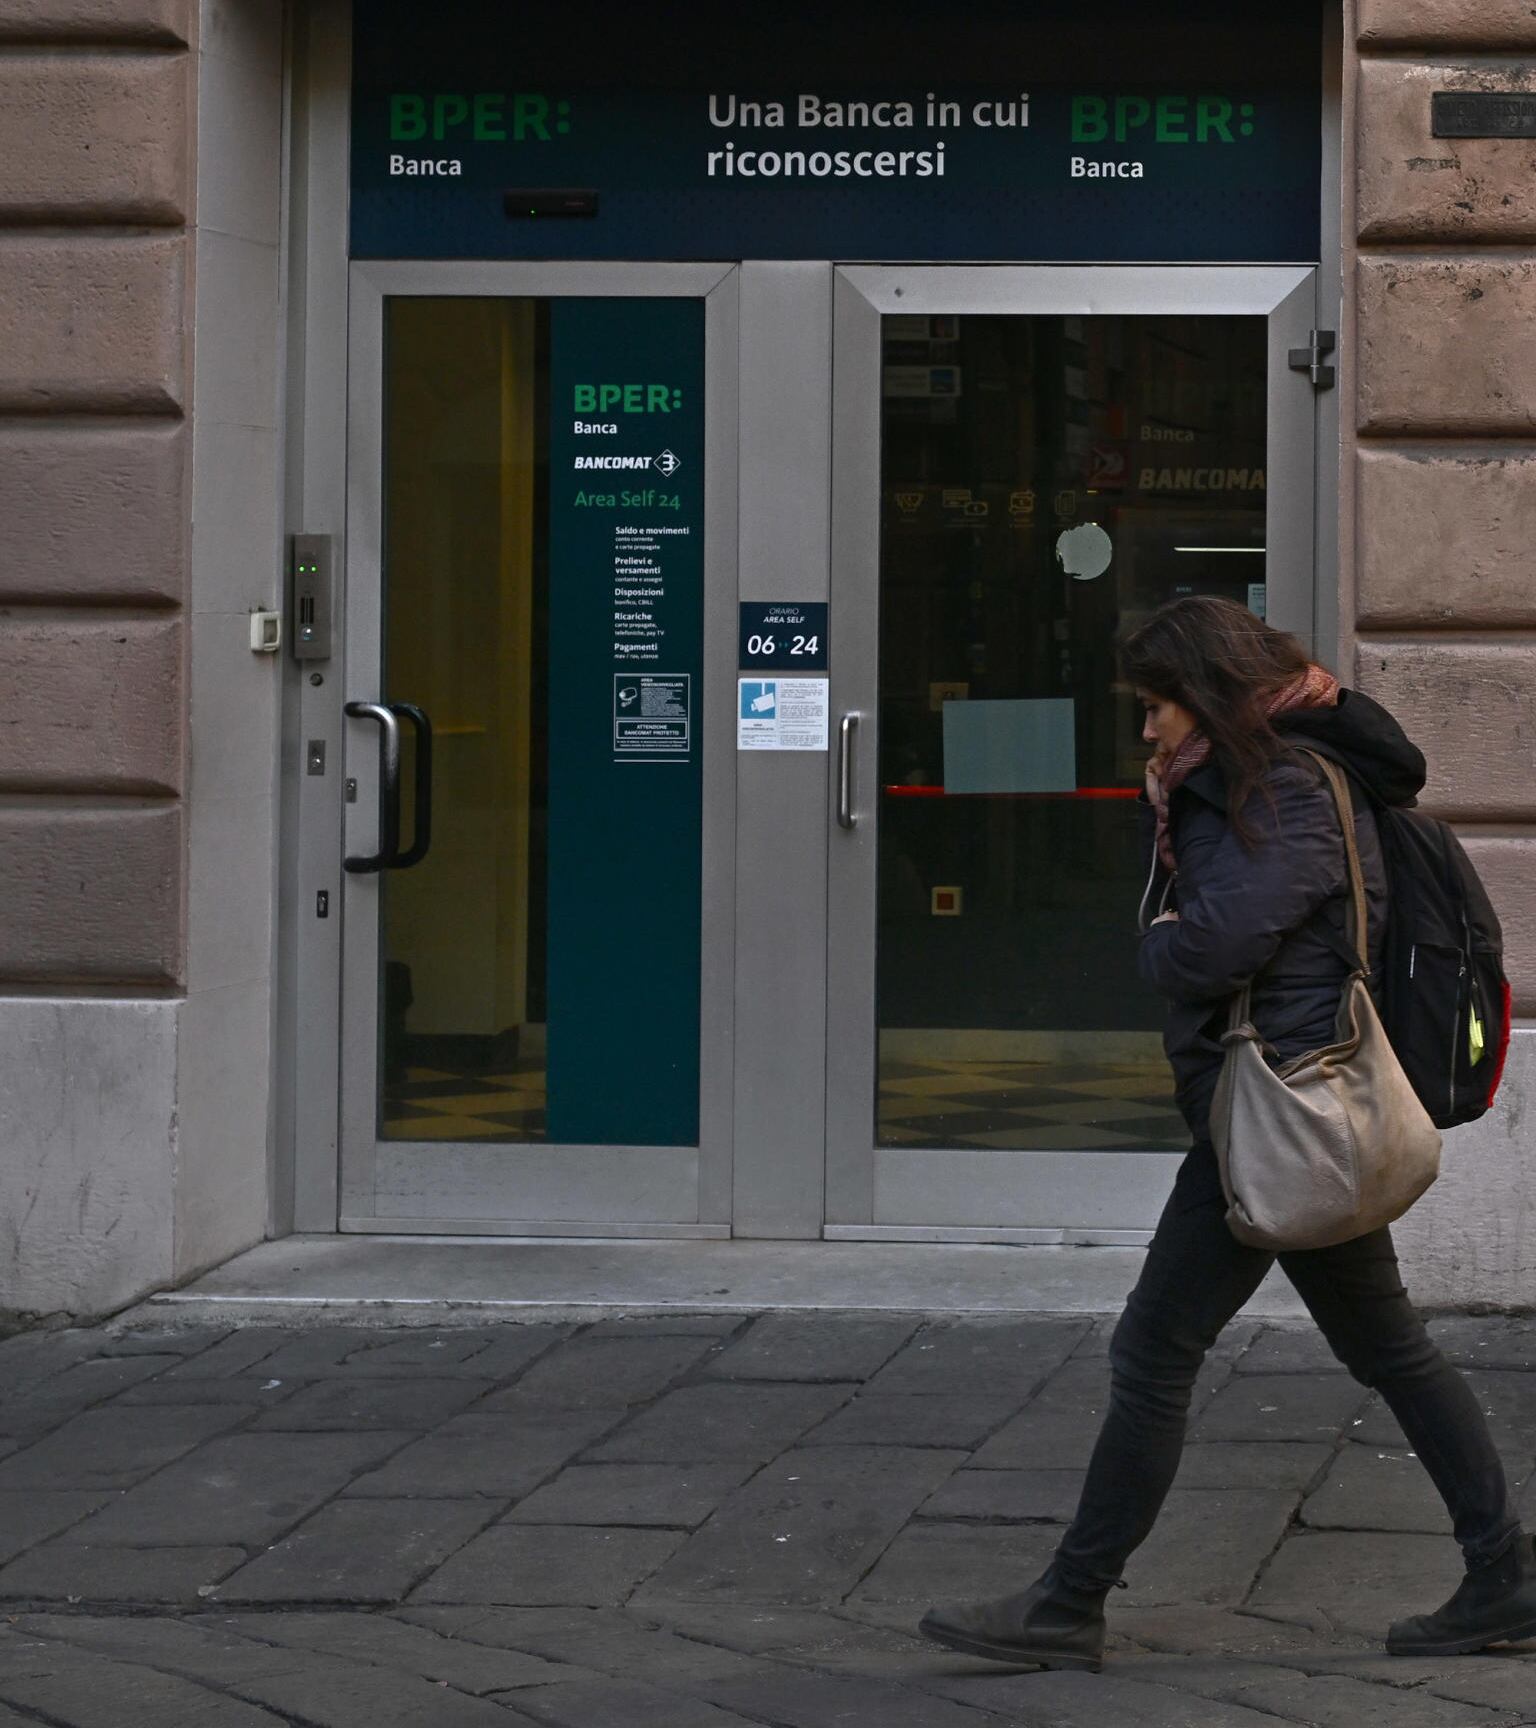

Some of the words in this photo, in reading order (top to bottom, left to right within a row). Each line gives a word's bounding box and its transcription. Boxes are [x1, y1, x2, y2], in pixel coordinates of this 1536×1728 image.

[389, 93, 572, 141] BPER:
[708, 94, 785, 128] Una
[798, 94, 914, 128] Banca
[926, 92, 961, 127] in
[972, 93, 1029, 127] cui
[1070, 95, 1255, 144] BPER:
[389, 154, 462, 176] Banca
[707, 141, 945, 177] riconoscersi
[1070, 156, 1144, 178] Banca
[574, 384, 682, 413] BPER:
[573, 420, 618, 435] Banca
[1140, 425, 1195, 443] Banca
[574, 456, 652, 470] BANCOMAT
[574, 490, 616, 508] Area
[621, 489, 655, 507] Self
[659, 494, 681, 511] 24
[615, 526, 637, 535] Saldo
[645, 526, 690, 535] movimenti
[614, 557, 646, 565] Prelievi
[615, 566, 661, 574] versamenti
[614, 588, 664, 597] Disposizioni
[614, 612, 652, 620] Ricariche
[769, 607, 799, 615] ORARIO
[614, 643, 658, 652] Pagamenti
[747, 634, 776, 655] 06
[790, 634, 819, 655] 24
